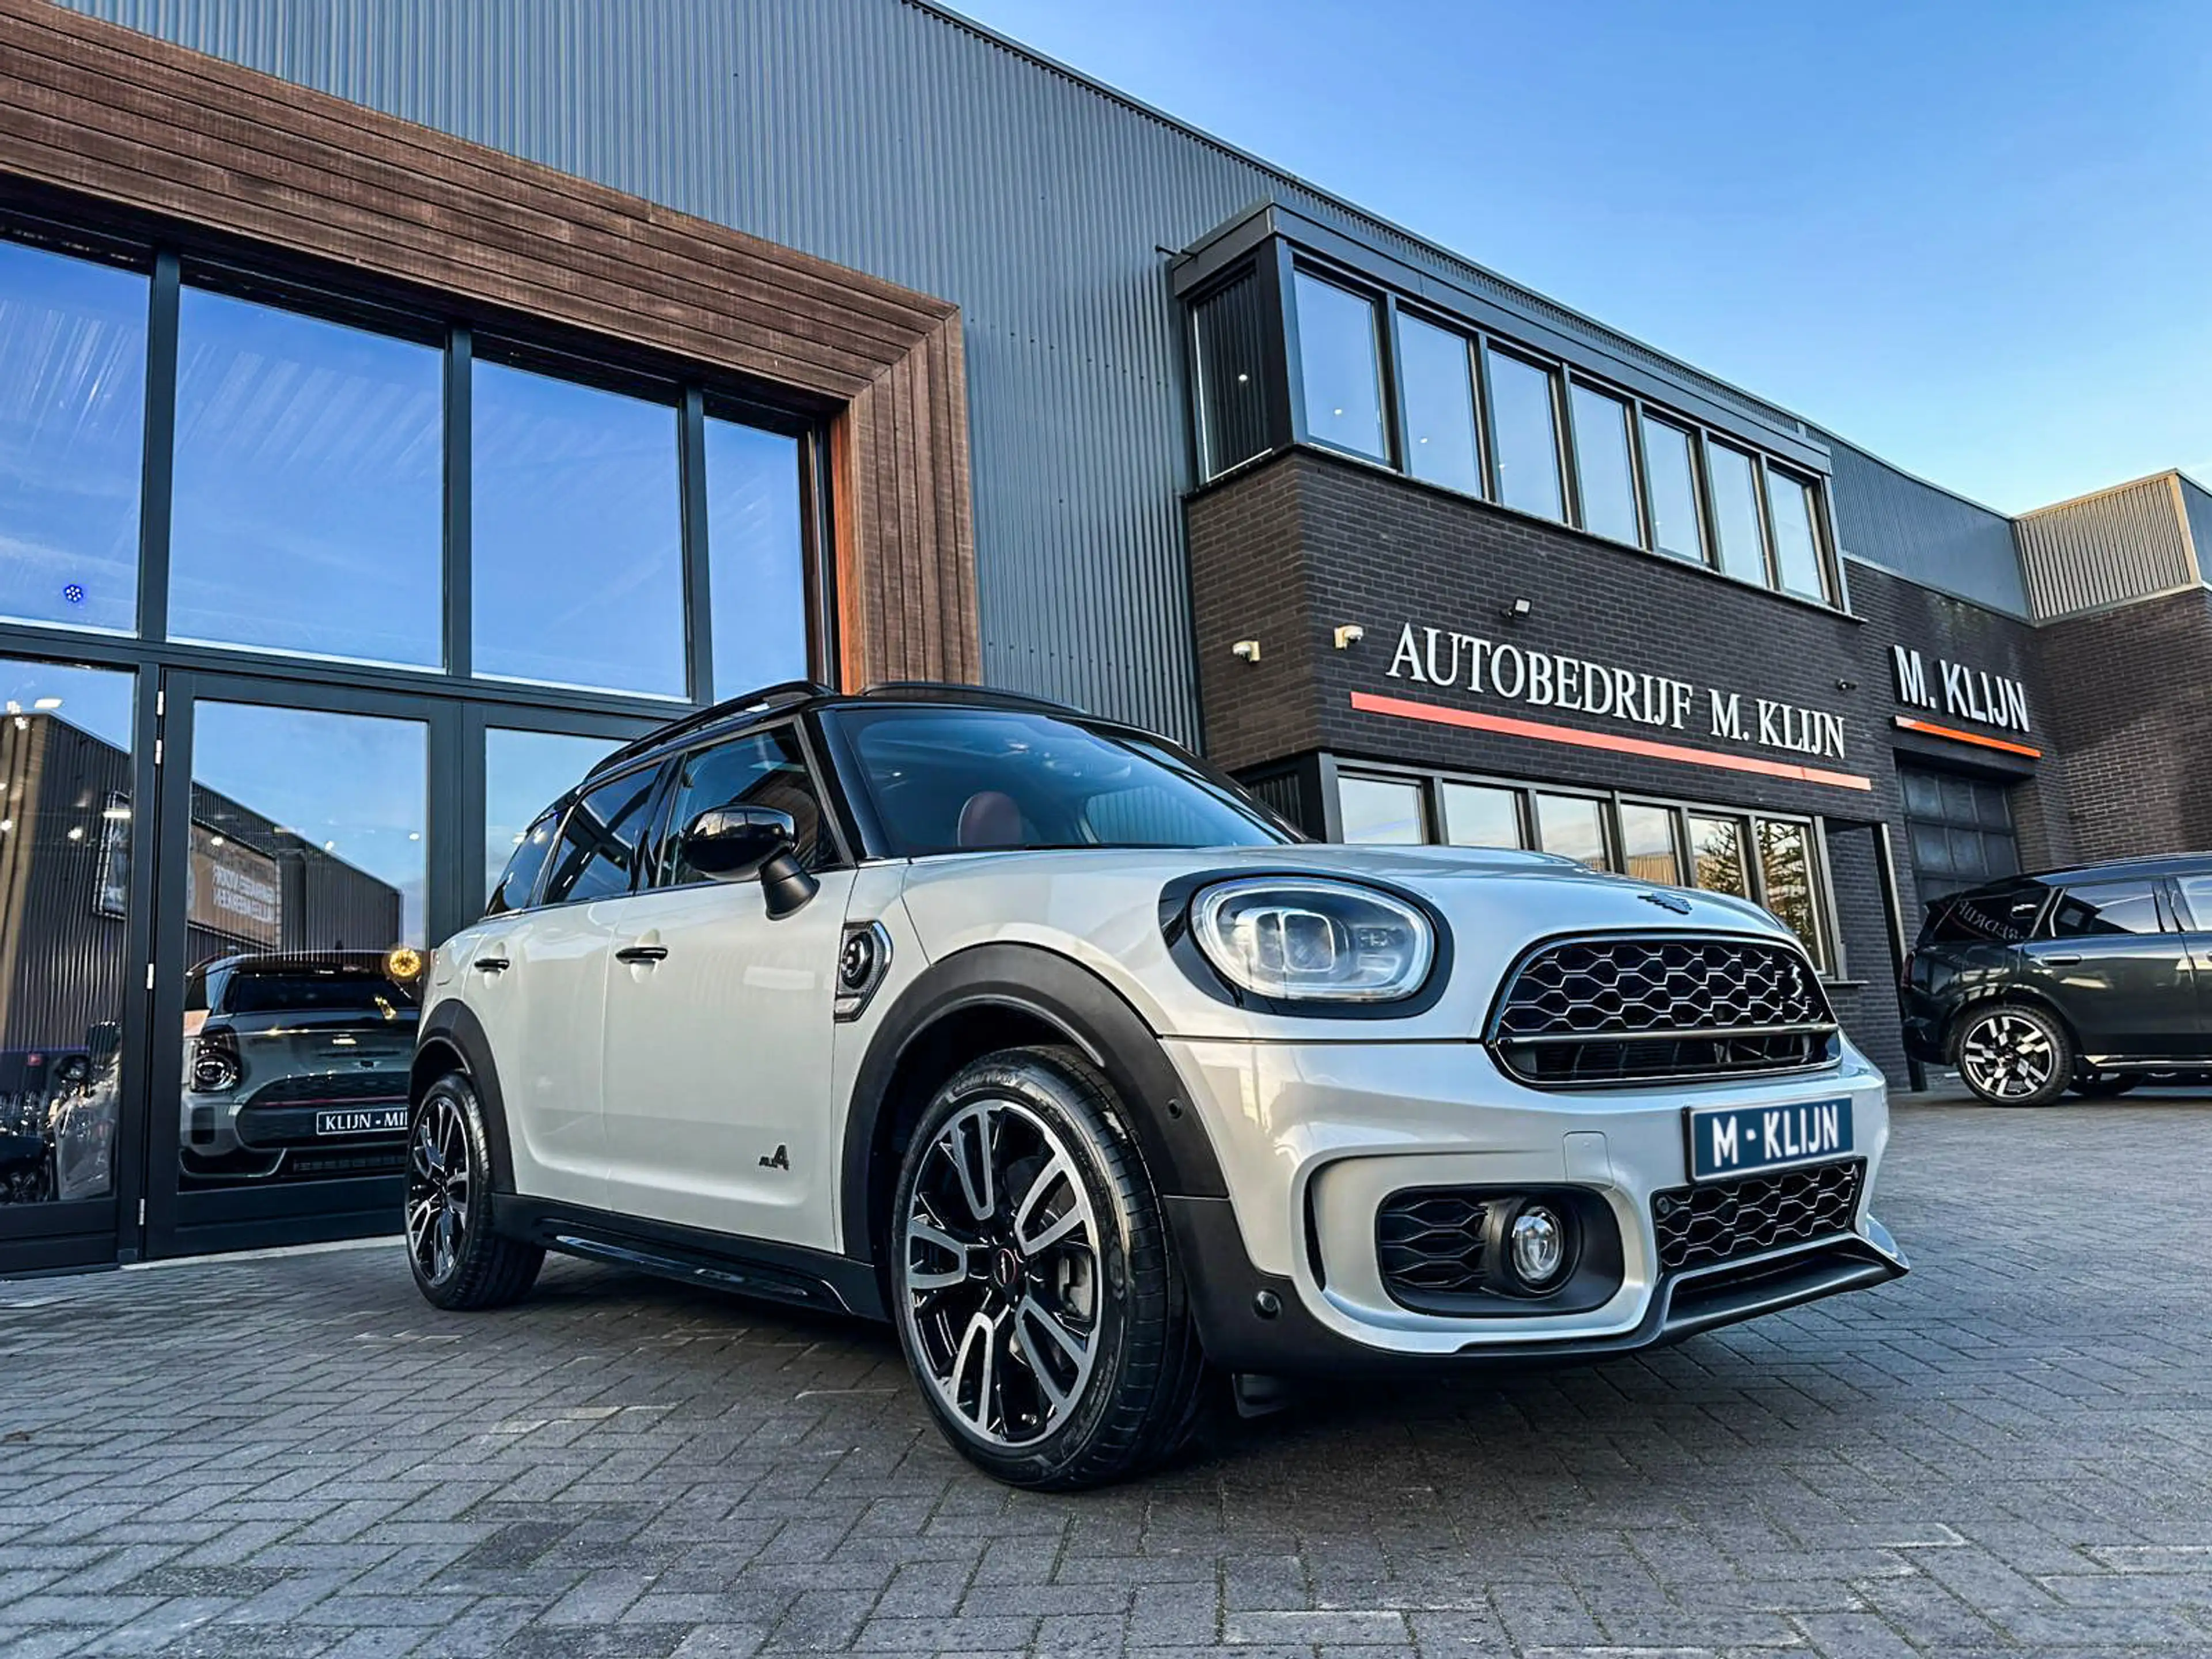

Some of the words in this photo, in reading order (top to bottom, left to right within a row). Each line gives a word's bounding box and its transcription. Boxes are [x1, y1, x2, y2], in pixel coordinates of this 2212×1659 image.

[1385, 622, 1693, 730] AUTOBEDRIJF
[1708, 688, 1749, 741] M.
[1756, 698, 1845, 759] KLIJN
[1894, 645, 1936, 709] M.
[1940, 659, 2030, 732] KLIJN
[325, 1112, 371, 1130] KLIJN
[1763, 1104, 1838, 1160] KLIJN
